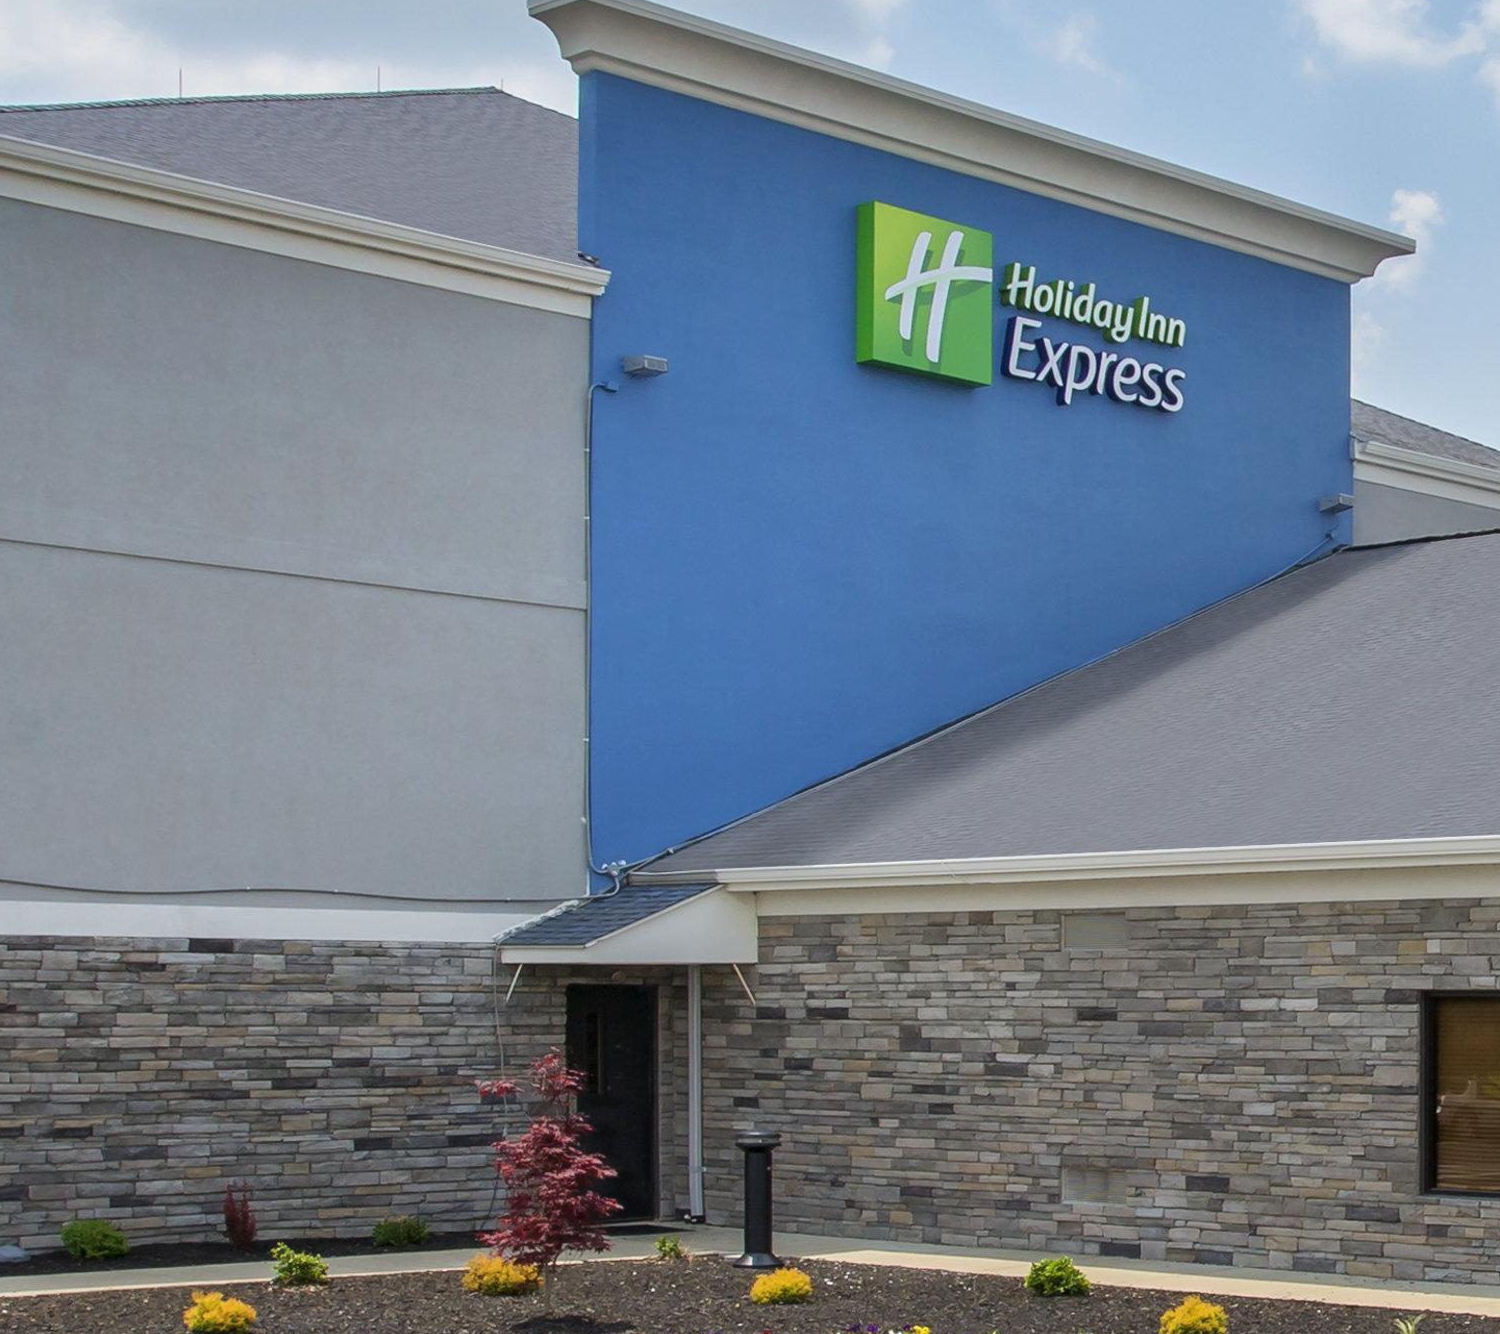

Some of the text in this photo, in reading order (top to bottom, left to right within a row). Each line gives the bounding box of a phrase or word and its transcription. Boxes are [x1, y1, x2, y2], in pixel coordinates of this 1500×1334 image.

[1005, 261, 1187, 347] Holiday Inn
[1006, 315, 1187, 414] Express
